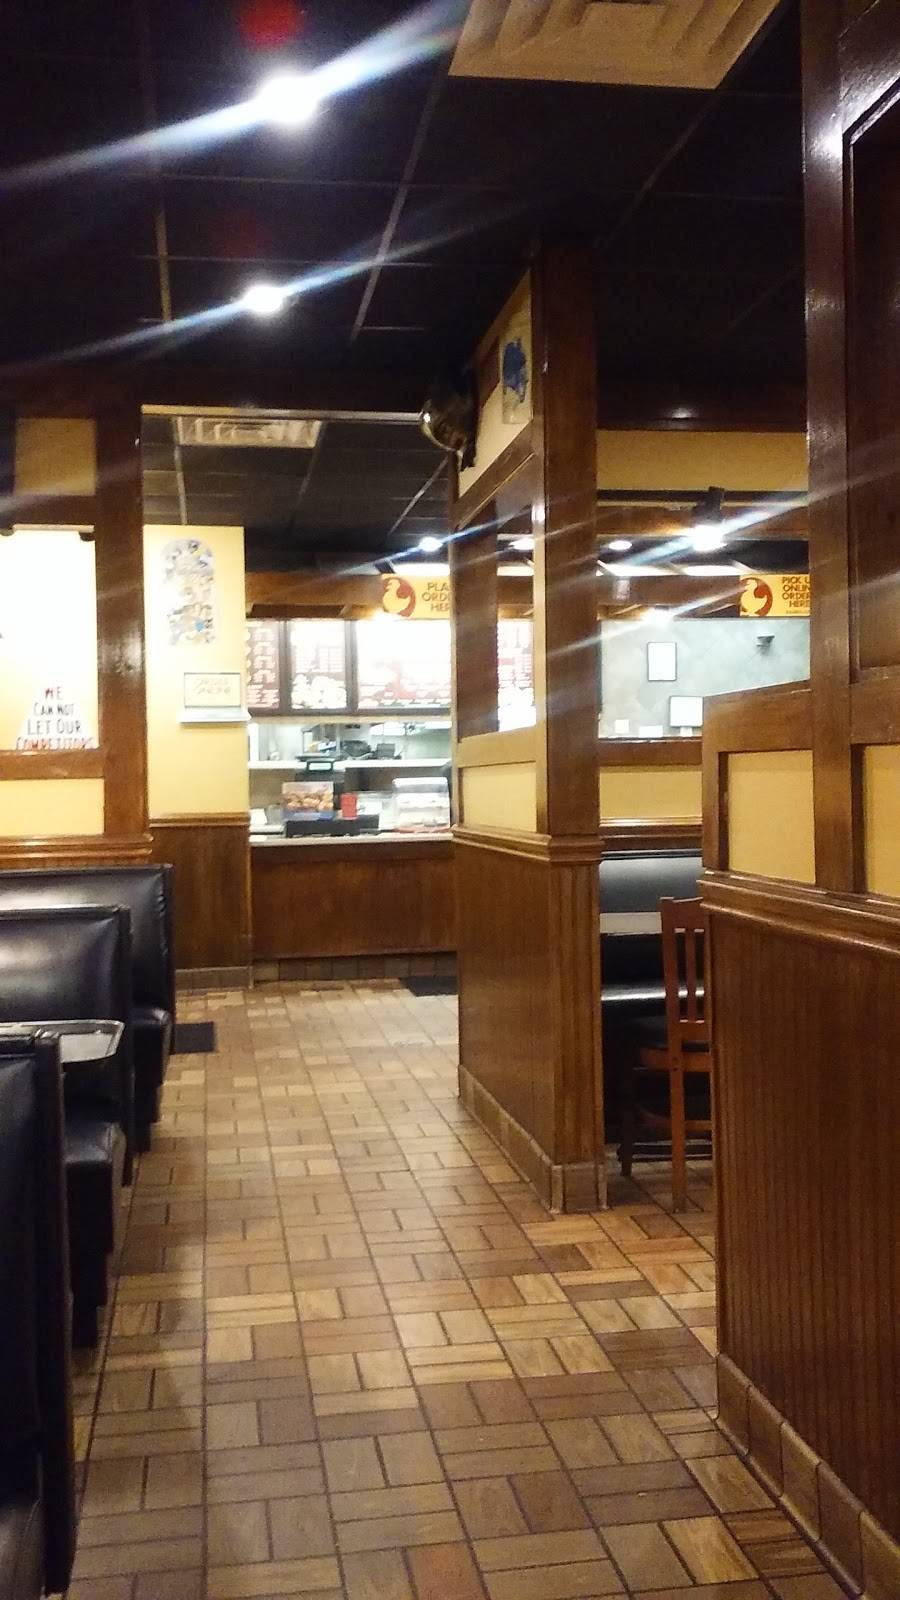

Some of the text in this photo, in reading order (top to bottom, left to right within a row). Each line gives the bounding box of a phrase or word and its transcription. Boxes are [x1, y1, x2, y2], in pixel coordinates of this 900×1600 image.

[781, 576, 802, 584] PICK
[427, 582, 450, 591] PLA
[782, 584, 811, 592] ONLIN
[421, 592, 452, 602] ORD
[430, 602, 451, 612] HER
[44, 686, 63, 700] WE
[57, 703, 75, 716] NOT
[27, 719, 82, 735] LET OUR
